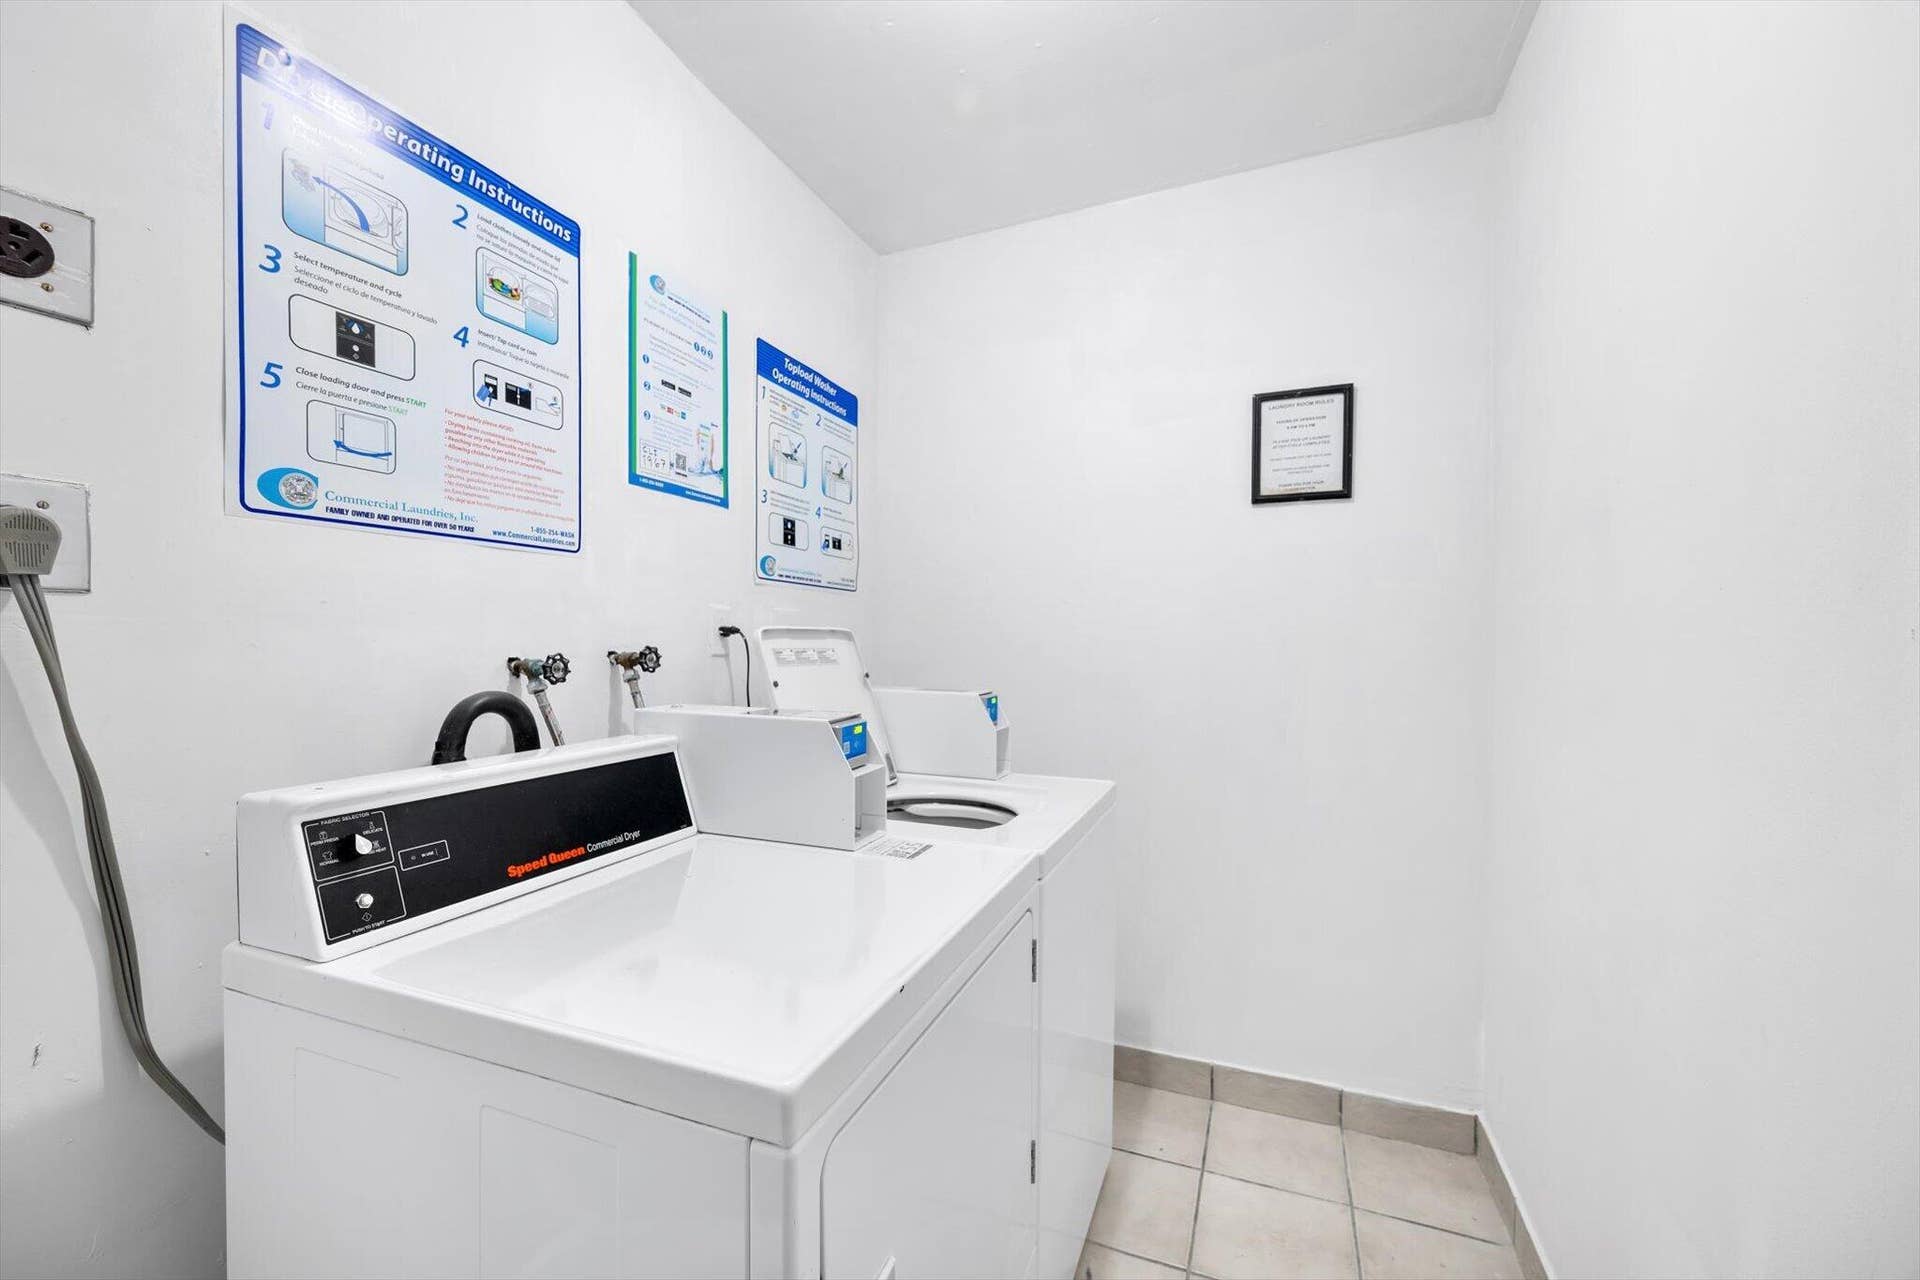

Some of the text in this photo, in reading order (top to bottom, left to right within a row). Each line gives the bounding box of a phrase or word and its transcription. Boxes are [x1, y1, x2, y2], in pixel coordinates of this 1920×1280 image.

[344, 100, 464, 183] Operating
[468, 170, 572, 242] Instructions
[452, 204, 468, 229] 2
[259, 244, 282, 274] 3
[293, 252, 402, 298] Select temperature and cycle
[294, 276, 328, 294] deseado
[294, 266, 334, 286] Seleccione
[343, 283, 359, 296] ciclo
[360, 289, 369, 299] de
[370, 294, 411, 316] temperatura
[417, 310, 438, 325] lavado
[453, 326, 469, 348] 4
[497, 336, 507, 346] Tap
[507, 340, 521, 351] card
[527, 349, 537, 357] coin
[260, 361, 283, 388] 5
[784, 357, 837, 397] Topload Washer
[295, 366, 427, 409] Close loading door and press START
[295, 381, 319, 393] Cierre
[319, 387, 327, 395] la
[328, 390, 353, 402] puerta
[358, 397, 387, 411] presione
[388, 404, 408, 416] START
[761, 385, 767, 400] 1
[772, 367, 810, 398] Operating
[810, 389, 847, 416] Instructions
[1268, 403, 1295, 411] LAUNDRY
[1315, 398, 1335, 406] RULES
[815, 413, 822, 427] 2
[325, 490, 399, 511] Commercial
[401, 503, 457, 521] Laundries,
[459, 510, 479, 523] Inc.
[760, 489, 768, 504] 3
[325, 505, 475, 533] FAMILY OWNED AND OPERATED FOR OVER 50 YEARS
[815, 506, 822, 520] 4
[492, 528, 576, 547] www.CommercialLaundries.com
[320, 812, 370, 826] FABRIC SELECTOR
[362, 827, 384, 836] DELICATE
[319, 858, 340, 867] NORMAL
[506, 830, 641, 878] Speed Queen Commercial Dryer
[352, 925, 365, 935] PUSH
